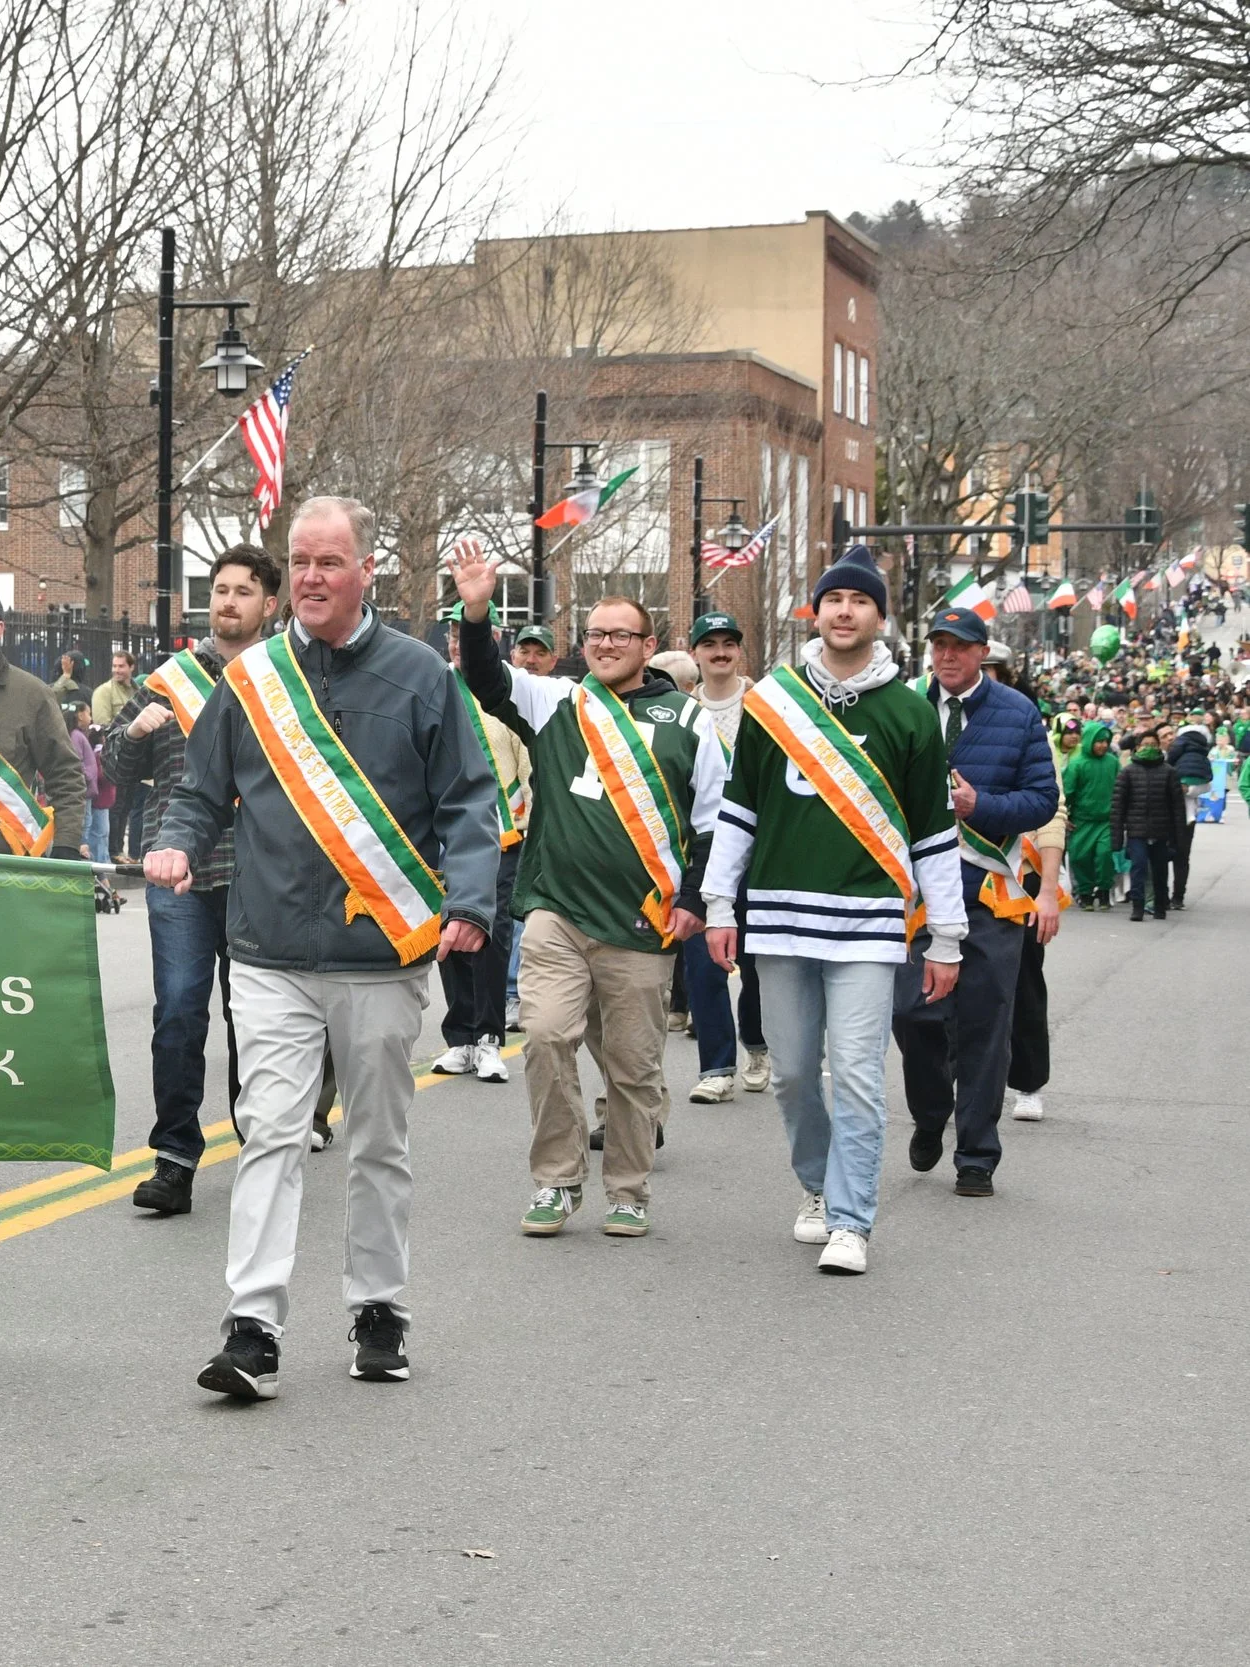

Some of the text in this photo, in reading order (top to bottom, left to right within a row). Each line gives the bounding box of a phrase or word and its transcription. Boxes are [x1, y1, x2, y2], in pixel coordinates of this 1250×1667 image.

[260, 672, 358, 828] FRIENDLY SONS OF ST. PATRICK
[811, 736, 846, 775] FRIENDLY
[840, 771, 863, 797] SONS
[856, 792, 872, 807] OF
[874, 817, 904, 854] PATRICK
[644, 806, 668, 845] PATRICK
